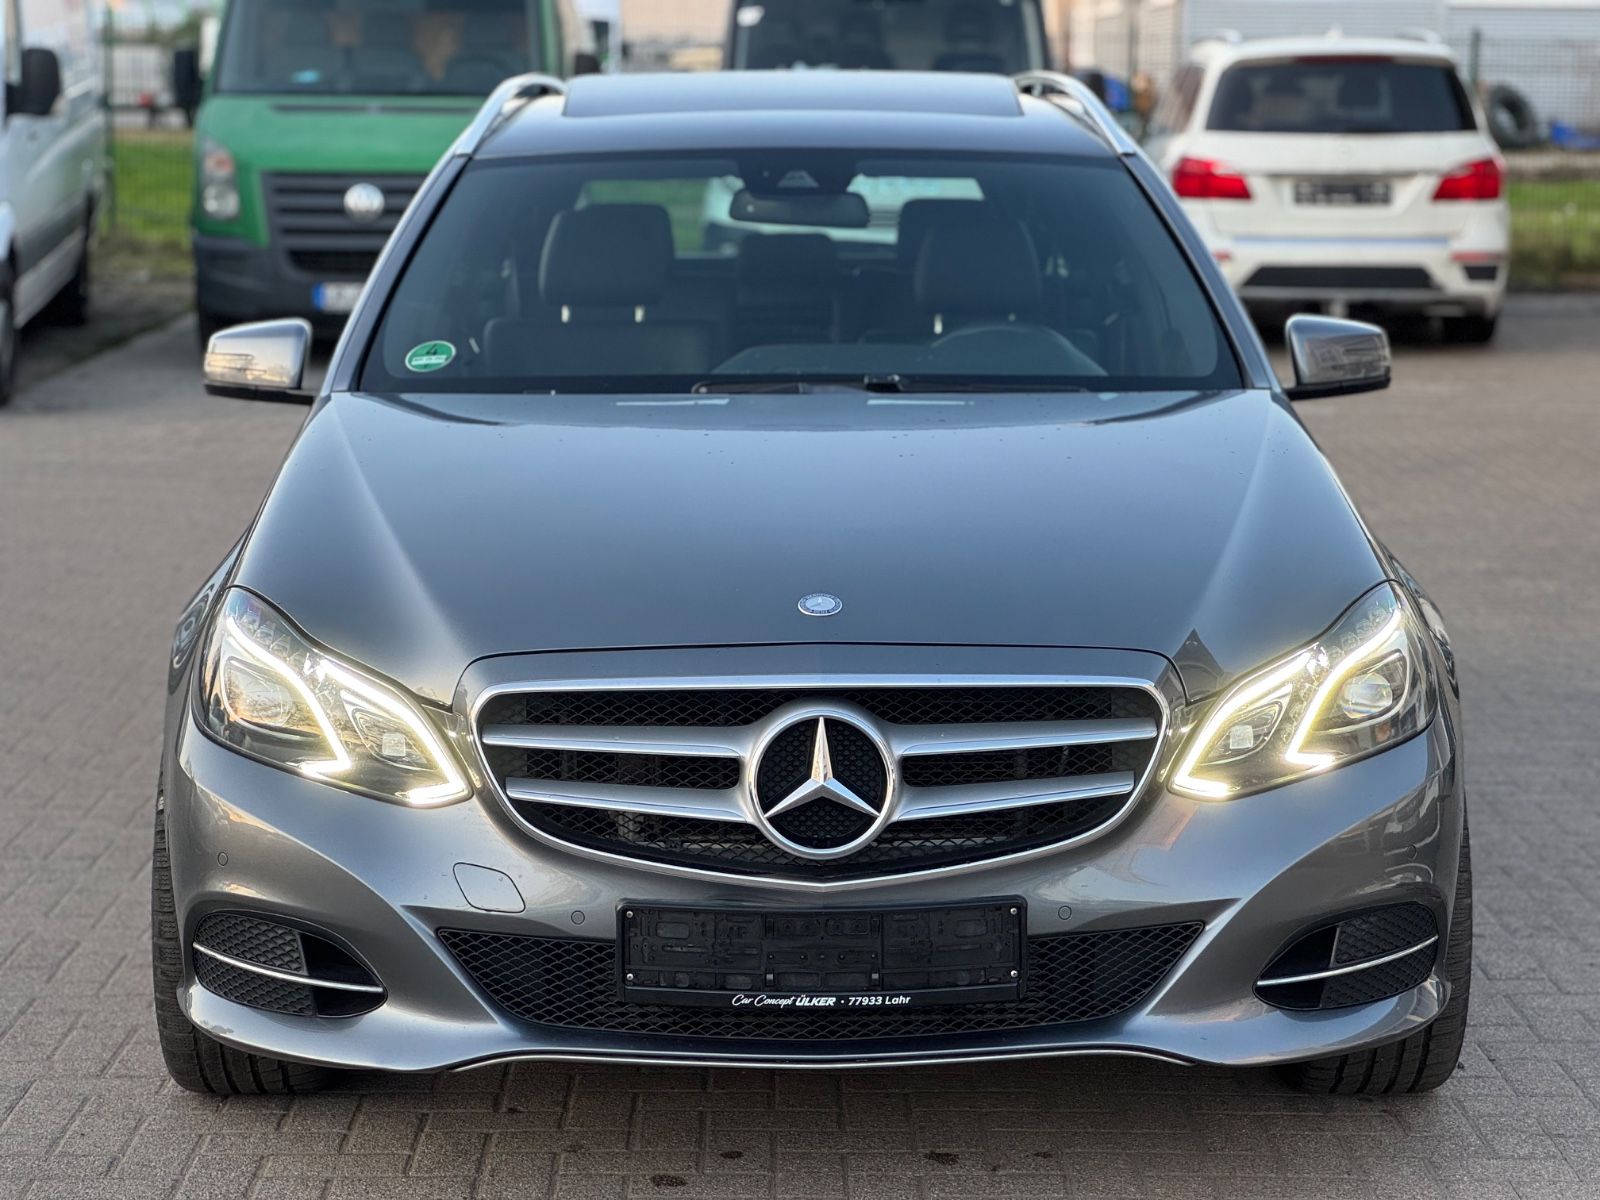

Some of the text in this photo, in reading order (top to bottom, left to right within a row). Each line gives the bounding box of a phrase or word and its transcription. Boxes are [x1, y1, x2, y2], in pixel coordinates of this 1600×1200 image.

[732, 994, 911, 1008] Car Concept ÜLKER 77933 Lahr
